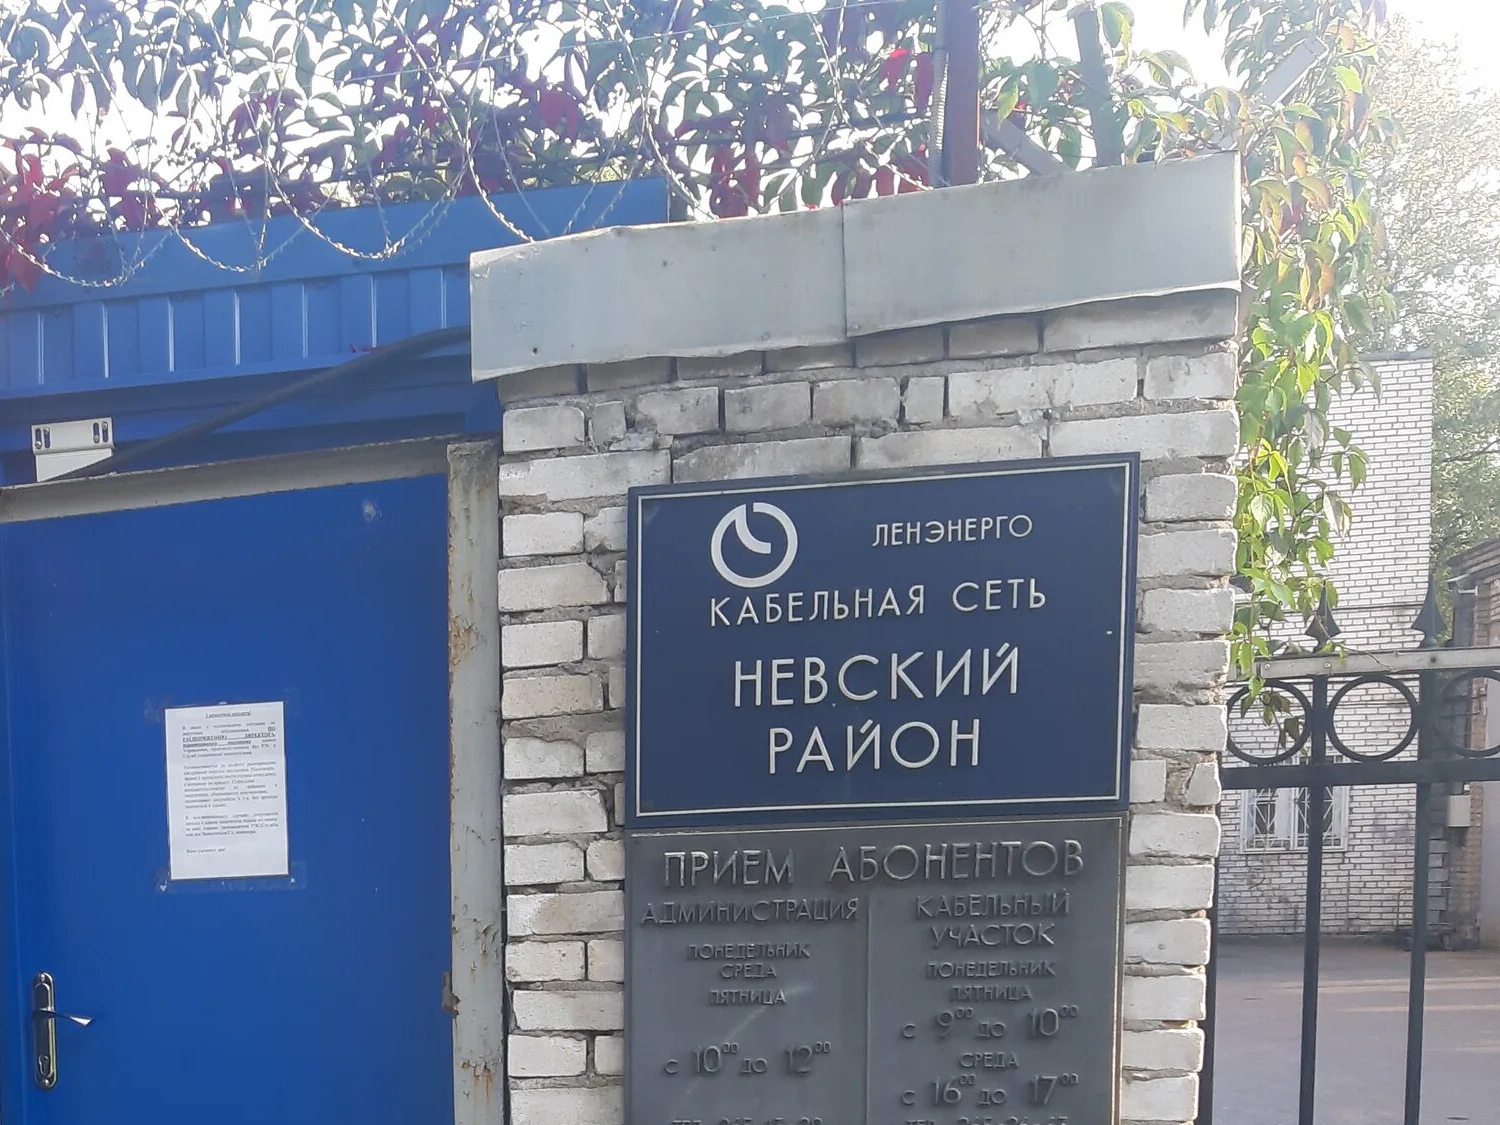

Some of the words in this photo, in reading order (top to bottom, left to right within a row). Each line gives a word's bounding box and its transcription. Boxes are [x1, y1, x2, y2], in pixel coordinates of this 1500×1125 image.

[872, 514, 1033, 547] ЛЕНЭНЕРГО
[710, 584, 925, 627] КАБЕЛЬНАЯ
[952, 578, 1047, 612] СЕТЬ
[734, 642, 1020, 707] НЕВСКИЙ
[768, 718, 980, 774] РАЙОН
[664, 848, 794, 887] ПРИЕМ
[828, 840, 1084, 883] АБОНЕНТОВ
[641, 897, 859, 924] АДМИНИСТРАЦИЯ
[916, 888, 1071, 919] КАБЕЛЬНЫЙ
[931, 923, 1056, 947] УЧАСТОК
[687, 943, 812, 960] ПОНЕДЕЛЬНИК
[719, 964, 777, 979] СРЕДА
[926, 961, 1057, 979] ПОНЕДЕЛЬНИК
[709, 988, 787, 1005] ПЯТНИЦА
[950, 985, 1033, 1002] ПЯТНИЦА
[958, 1051, 1020, 1069] СРЕДА
